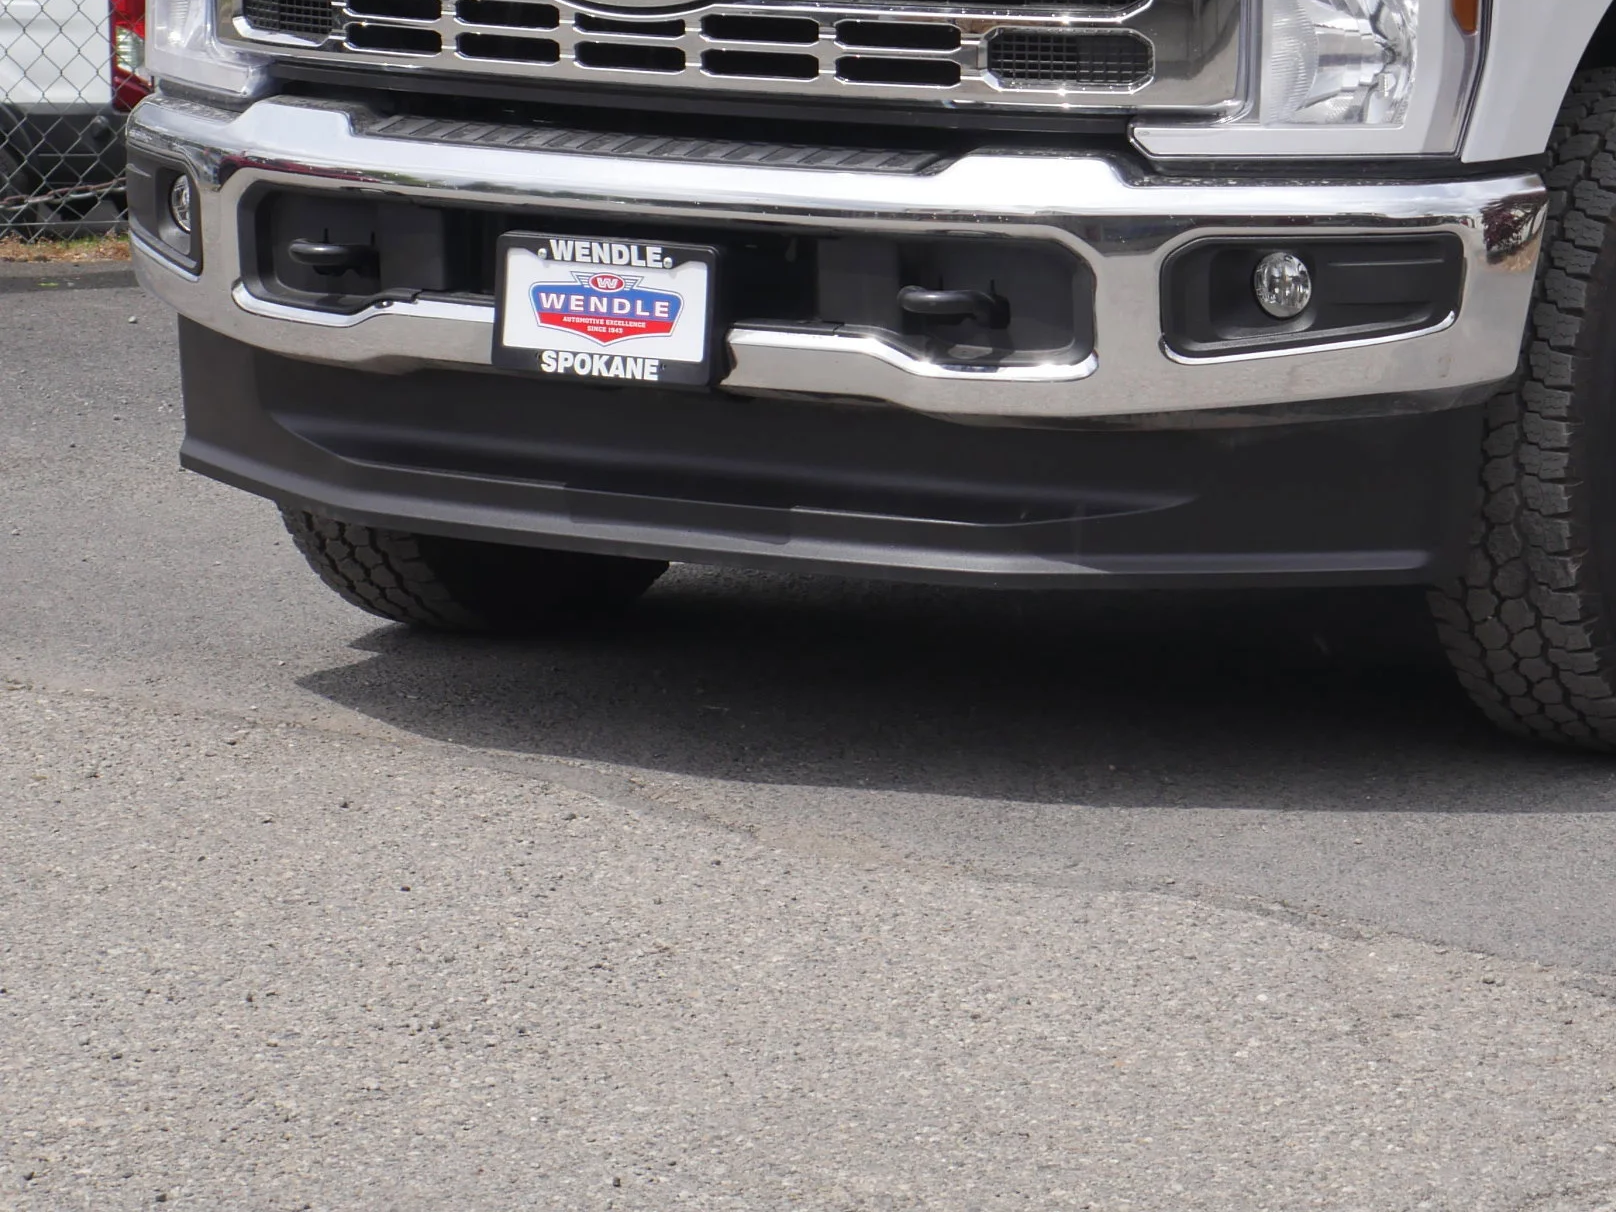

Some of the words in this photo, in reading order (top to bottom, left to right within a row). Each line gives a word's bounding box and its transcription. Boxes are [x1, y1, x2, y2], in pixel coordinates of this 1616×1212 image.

[549, 240, 663, 268] WENDLE
[539, 293, 669, 318] WENDLE
[562, 315, 604, 325] AUTOMOTIVE
[605, 319, 646, 328] EXCELLENCE
[587, 325, 607, 333] SINCE
[540, 350, 660, 381] SPOKANE
